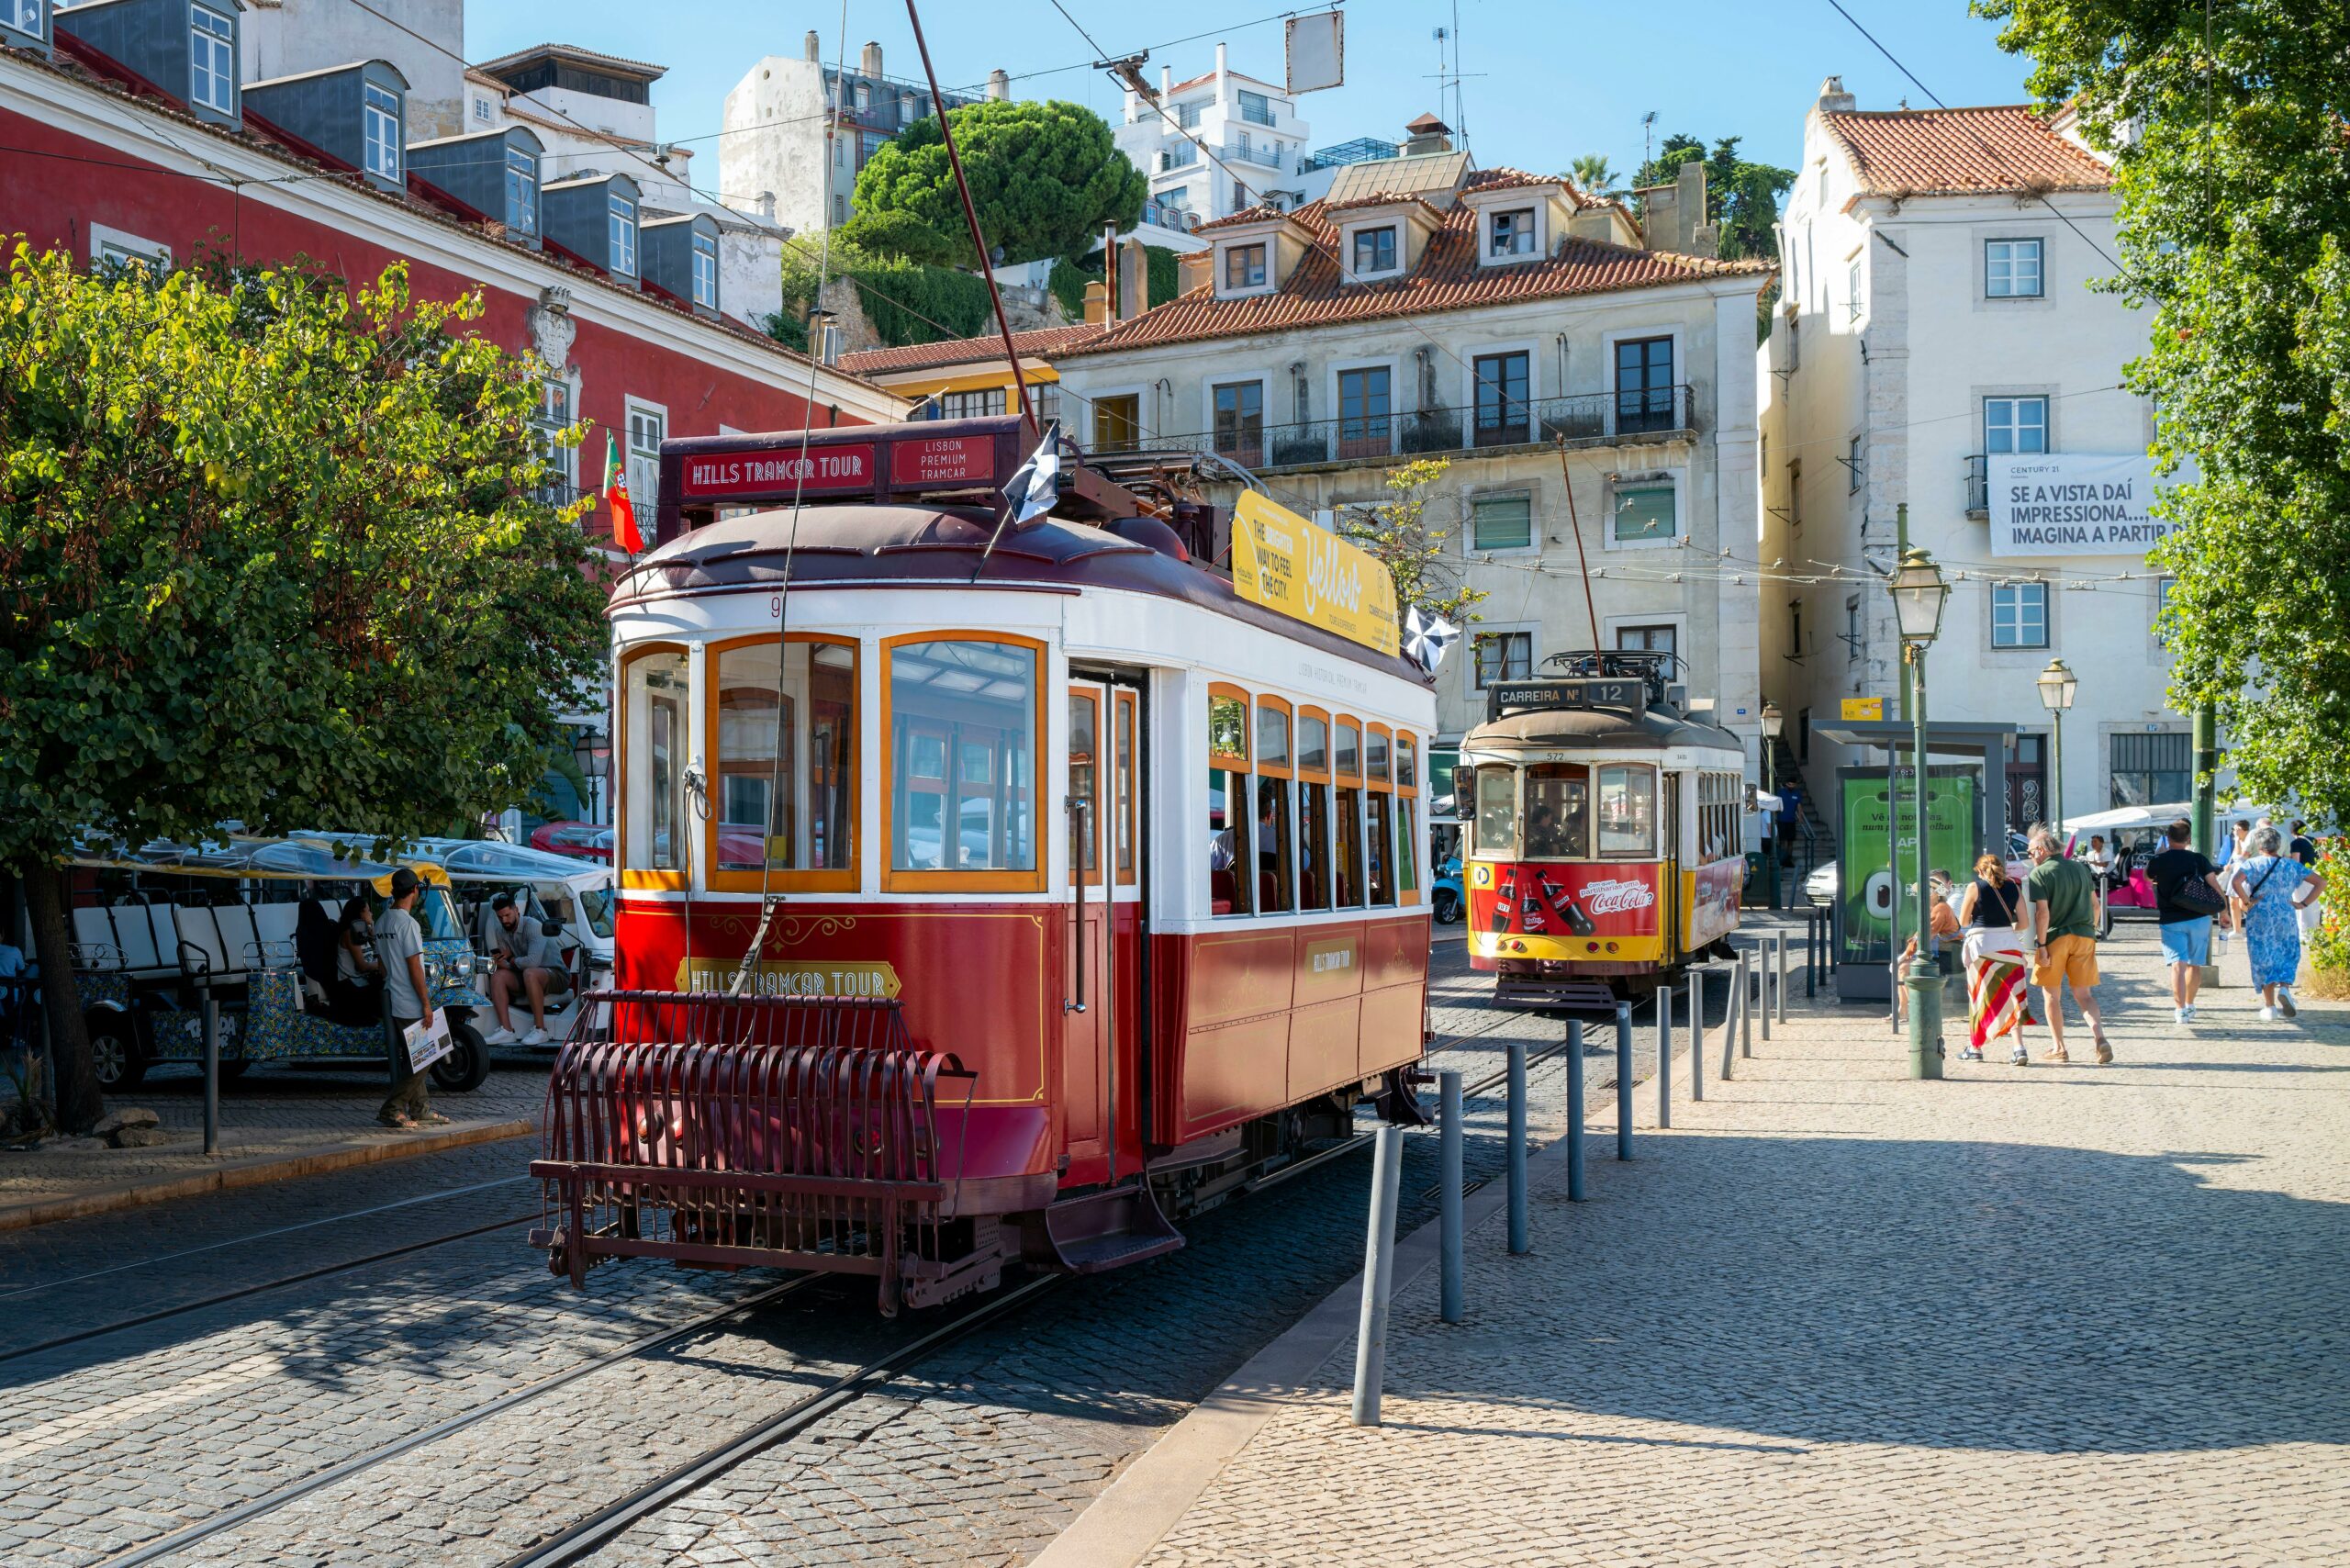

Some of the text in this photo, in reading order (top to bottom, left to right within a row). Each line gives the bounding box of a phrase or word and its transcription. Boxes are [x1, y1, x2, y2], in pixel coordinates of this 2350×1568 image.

[925, 440, 963, 453] LISBON
[921, 454, 967, 466] PREMIUM
[692, 454, 863, 486] HILLS TRAMCAR TOUR
[921, 467, 967, 480] TRAMCAR
[2010, 477, 2132, 502] SE A VISTA DAÍ
[1254, 518, 1265, 542] THE
[2012, 526, 2088, 544] IMAGINA
[2091, 525, 2105, 543] A
[1257, 545, 1292, 579] WAY TO FEEL
[1262, 572, 1273, 595] THE
[1274, 577, 1289, 600] CITY.
[771, 596, 780, 619] 9
[1500, 690, 1560, 703] CARREIRA
[1601, 686, 1622, 700] 12
[1547, 752, 1564, 761] 572
[1872, 812, 1885, 822] Vê
[1624, 880, 1639, 889] uma
[832, 971, 886, 996] TOUR
